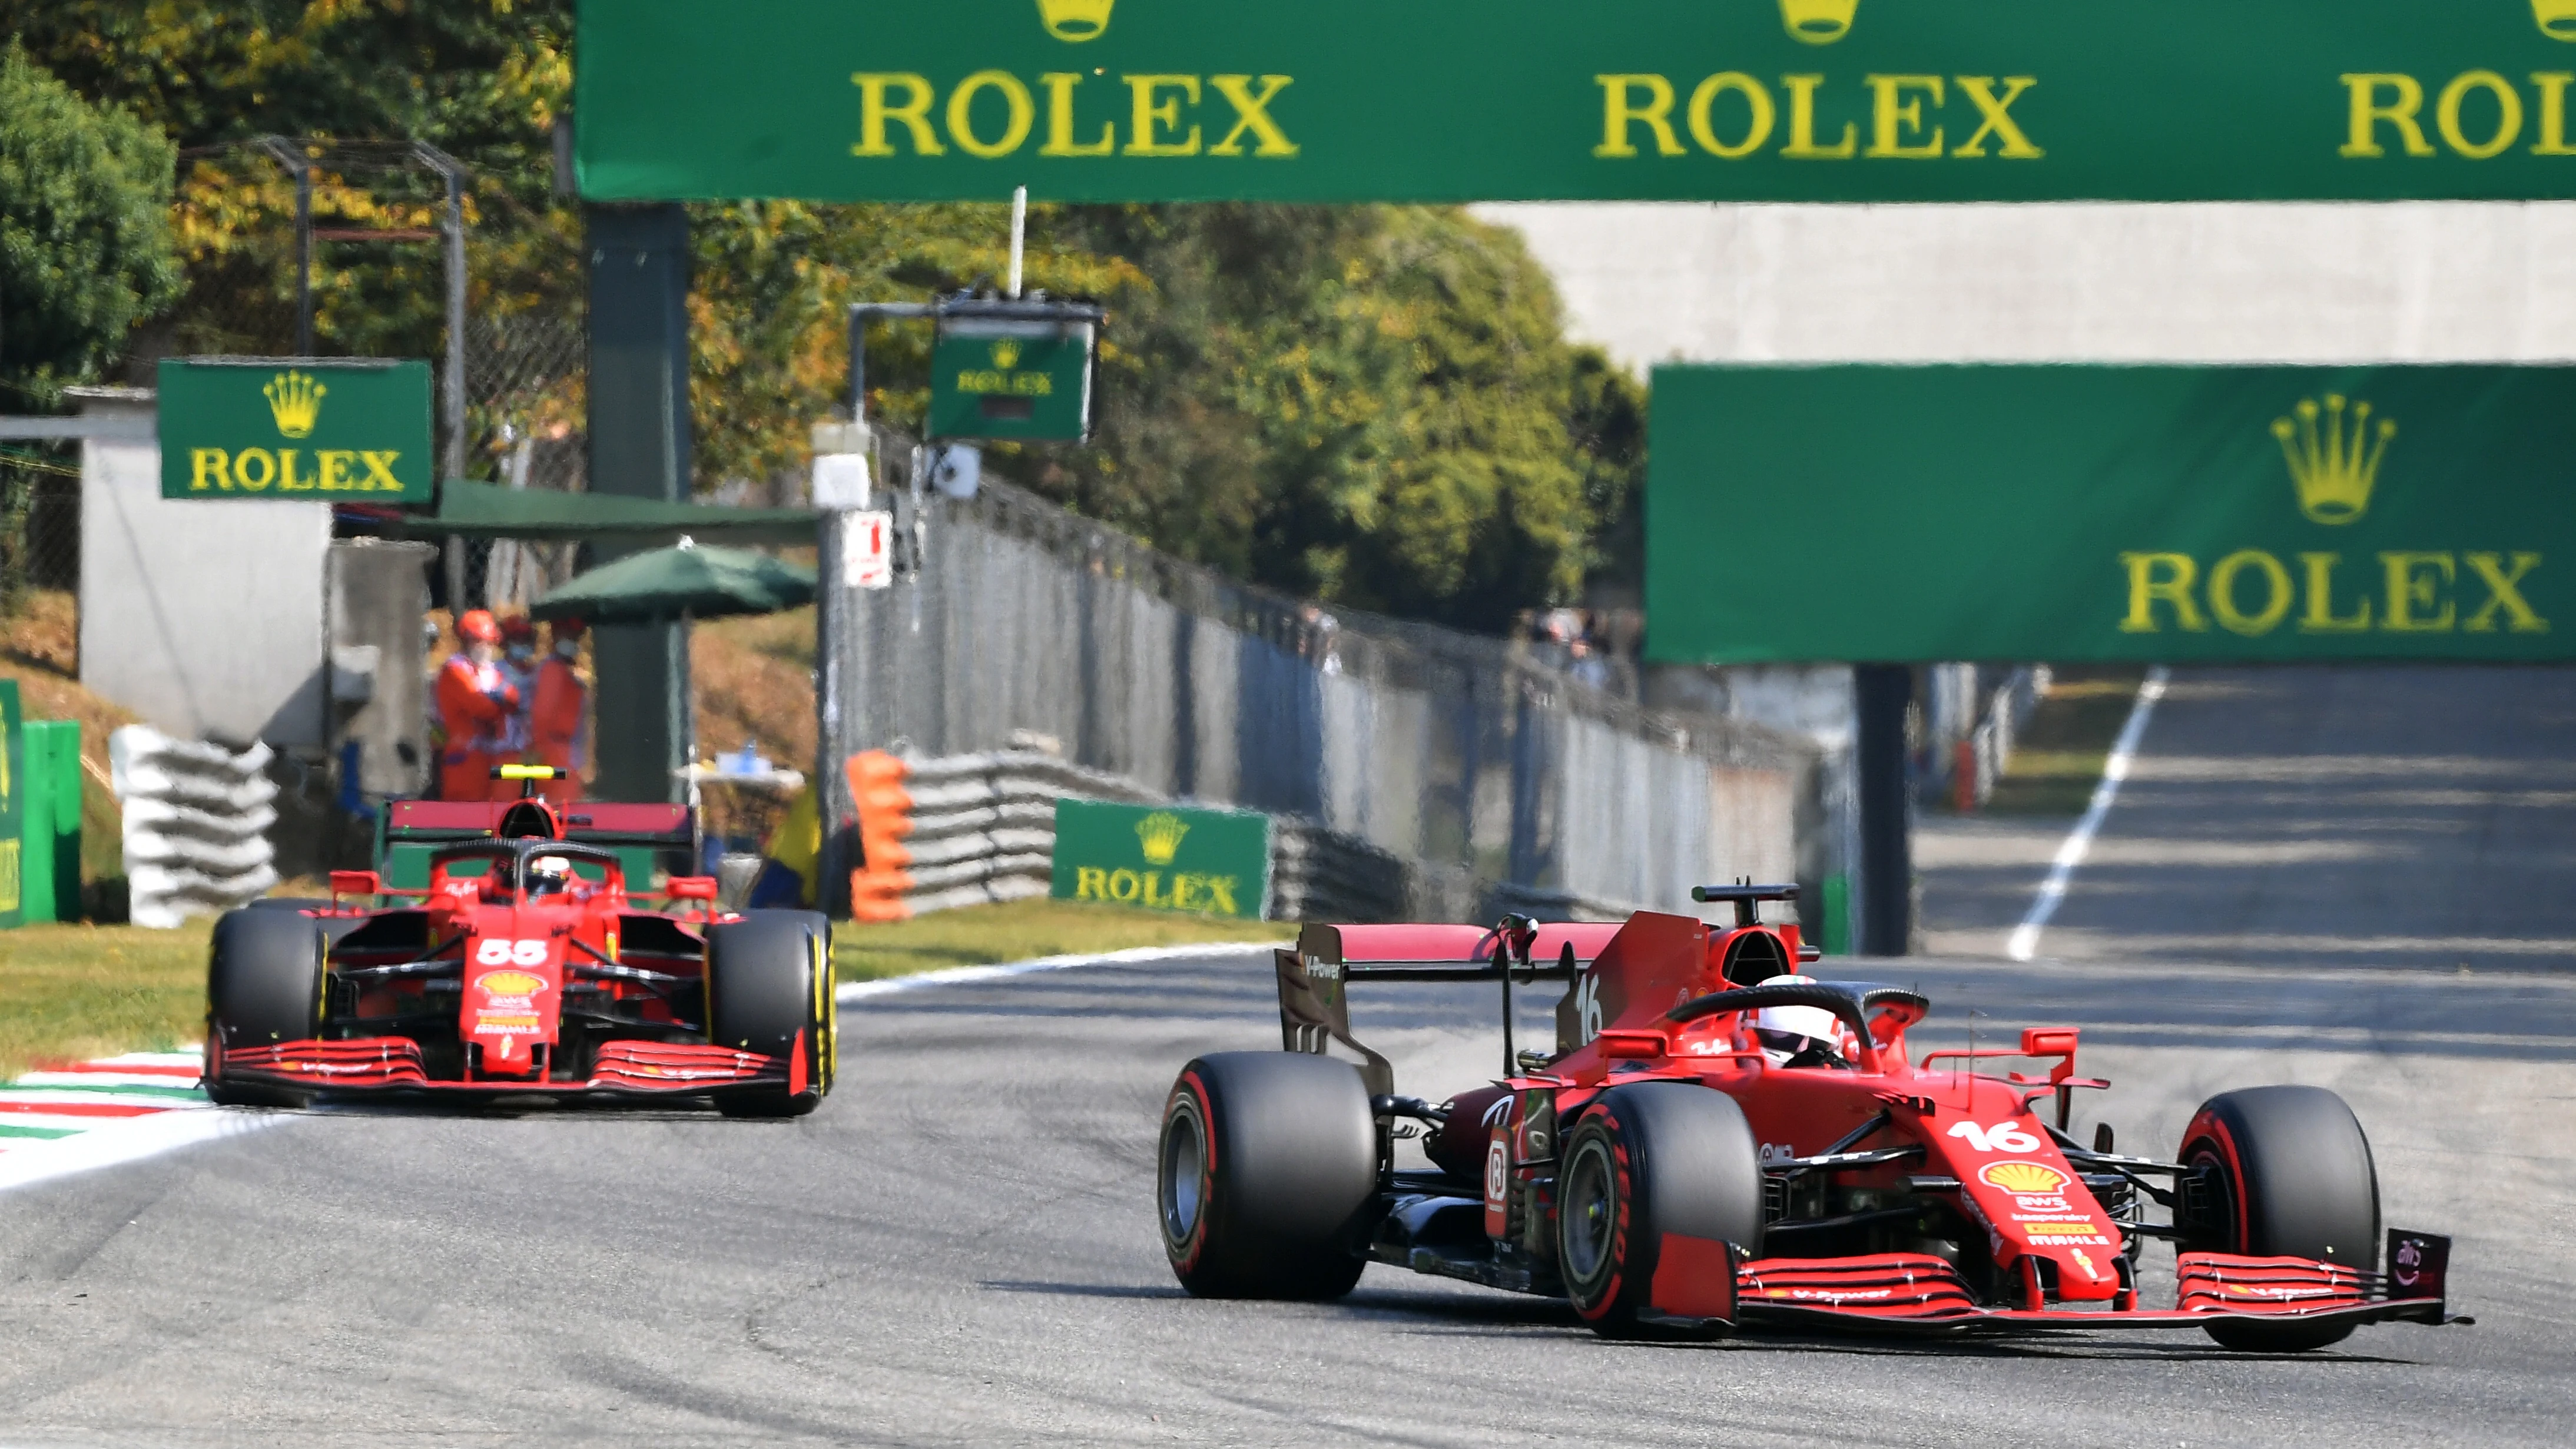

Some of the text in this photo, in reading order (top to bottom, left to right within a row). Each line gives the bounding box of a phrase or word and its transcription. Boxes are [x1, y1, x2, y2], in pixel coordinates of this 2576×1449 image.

[851, 67, 1299, 159] ROLEX
[1594, 71, 2044, 160] ROLEX
[957, 370, 1052, 396] ROLEX
[190, 446, 405, 492] ROLEX
[2121, 550, 2551, 636] ROLEX
[1076, 866, 1239, 914] ROLEX
[476, 939, 548, 967] 55
[1304, 954, 1341, 980] V-Power
[1576, 973, 1602, 1046] 16
[1947, 1120, 2041, 1153] 16
[2015, 1196, 2067, 1206] aws
[2027, 1235, 2110, 1246] MAHLE
[1792, 1289, 1891, 1299] V-Power
